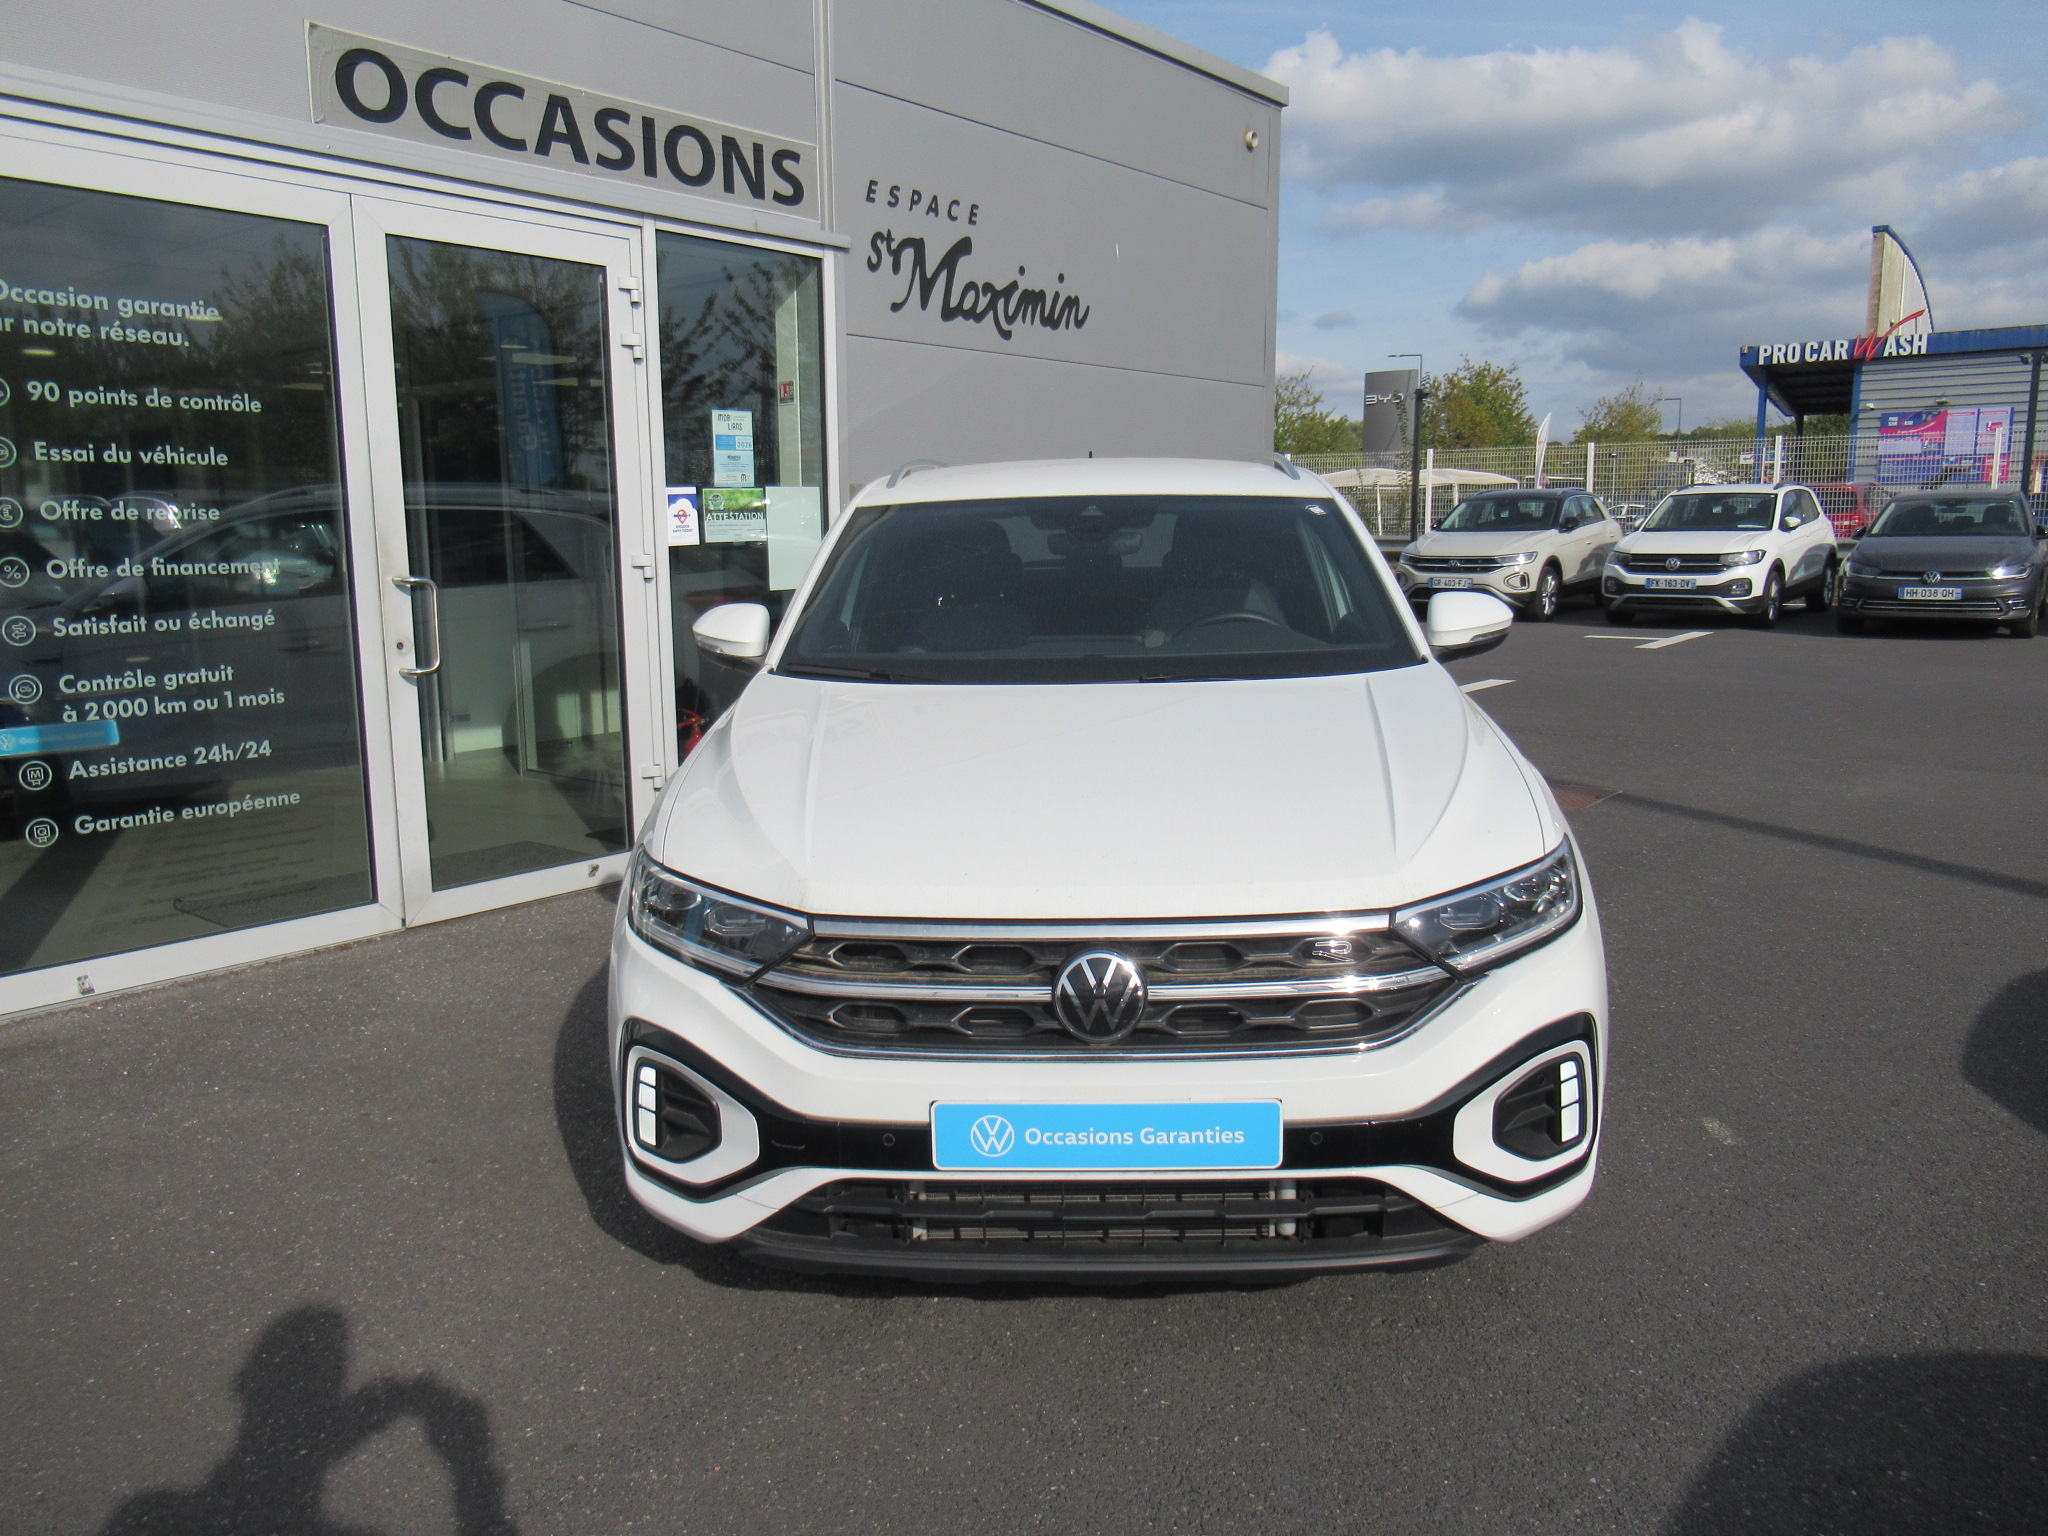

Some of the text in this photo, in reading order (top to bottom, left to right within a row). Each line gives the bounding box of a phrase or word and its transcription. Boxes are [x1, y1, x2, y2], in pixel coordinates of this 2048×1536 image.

[334, 47, 806, 207] OCCASIONS
[865, 179, 980, 226] ESPACE
[866, 229, 1090, 341] St Maximin
[117, 297, 221, 319] garantie
[23, 317, 92, 339] notre
[100, 320, 190, 347] réseau.
[1759, 309, 1928, 366] PRO CAR WASH
[27, 381, 262, 413] 90 points de contrôle
[33, 441, 229, 466] Essai du véhicule
[40, 500, 221, 527] Offre de reprise
[706, 511, 765, 521] ATTESTATION
[46, 556, 281, 580] Offre de financement
[53, 609, 276, 637] Satisfait ou échangé
[59, 665, 234, 694] Contrôle gratuit
[62, 705, 78, 723] à
[154, 696, 187, 716] km
[193, 697, 219, 713] ou
[224, 690, 233, 708] 1
[239, 688, 286, 708] mois
[69, 739, 273, 780] Assistance 24h/24
[75, 791, 301, 835] Garantie européenne
[1025, 1127, 1134, 1146] Occasions
[1140, 1126, 1245, 1145] Garanties
